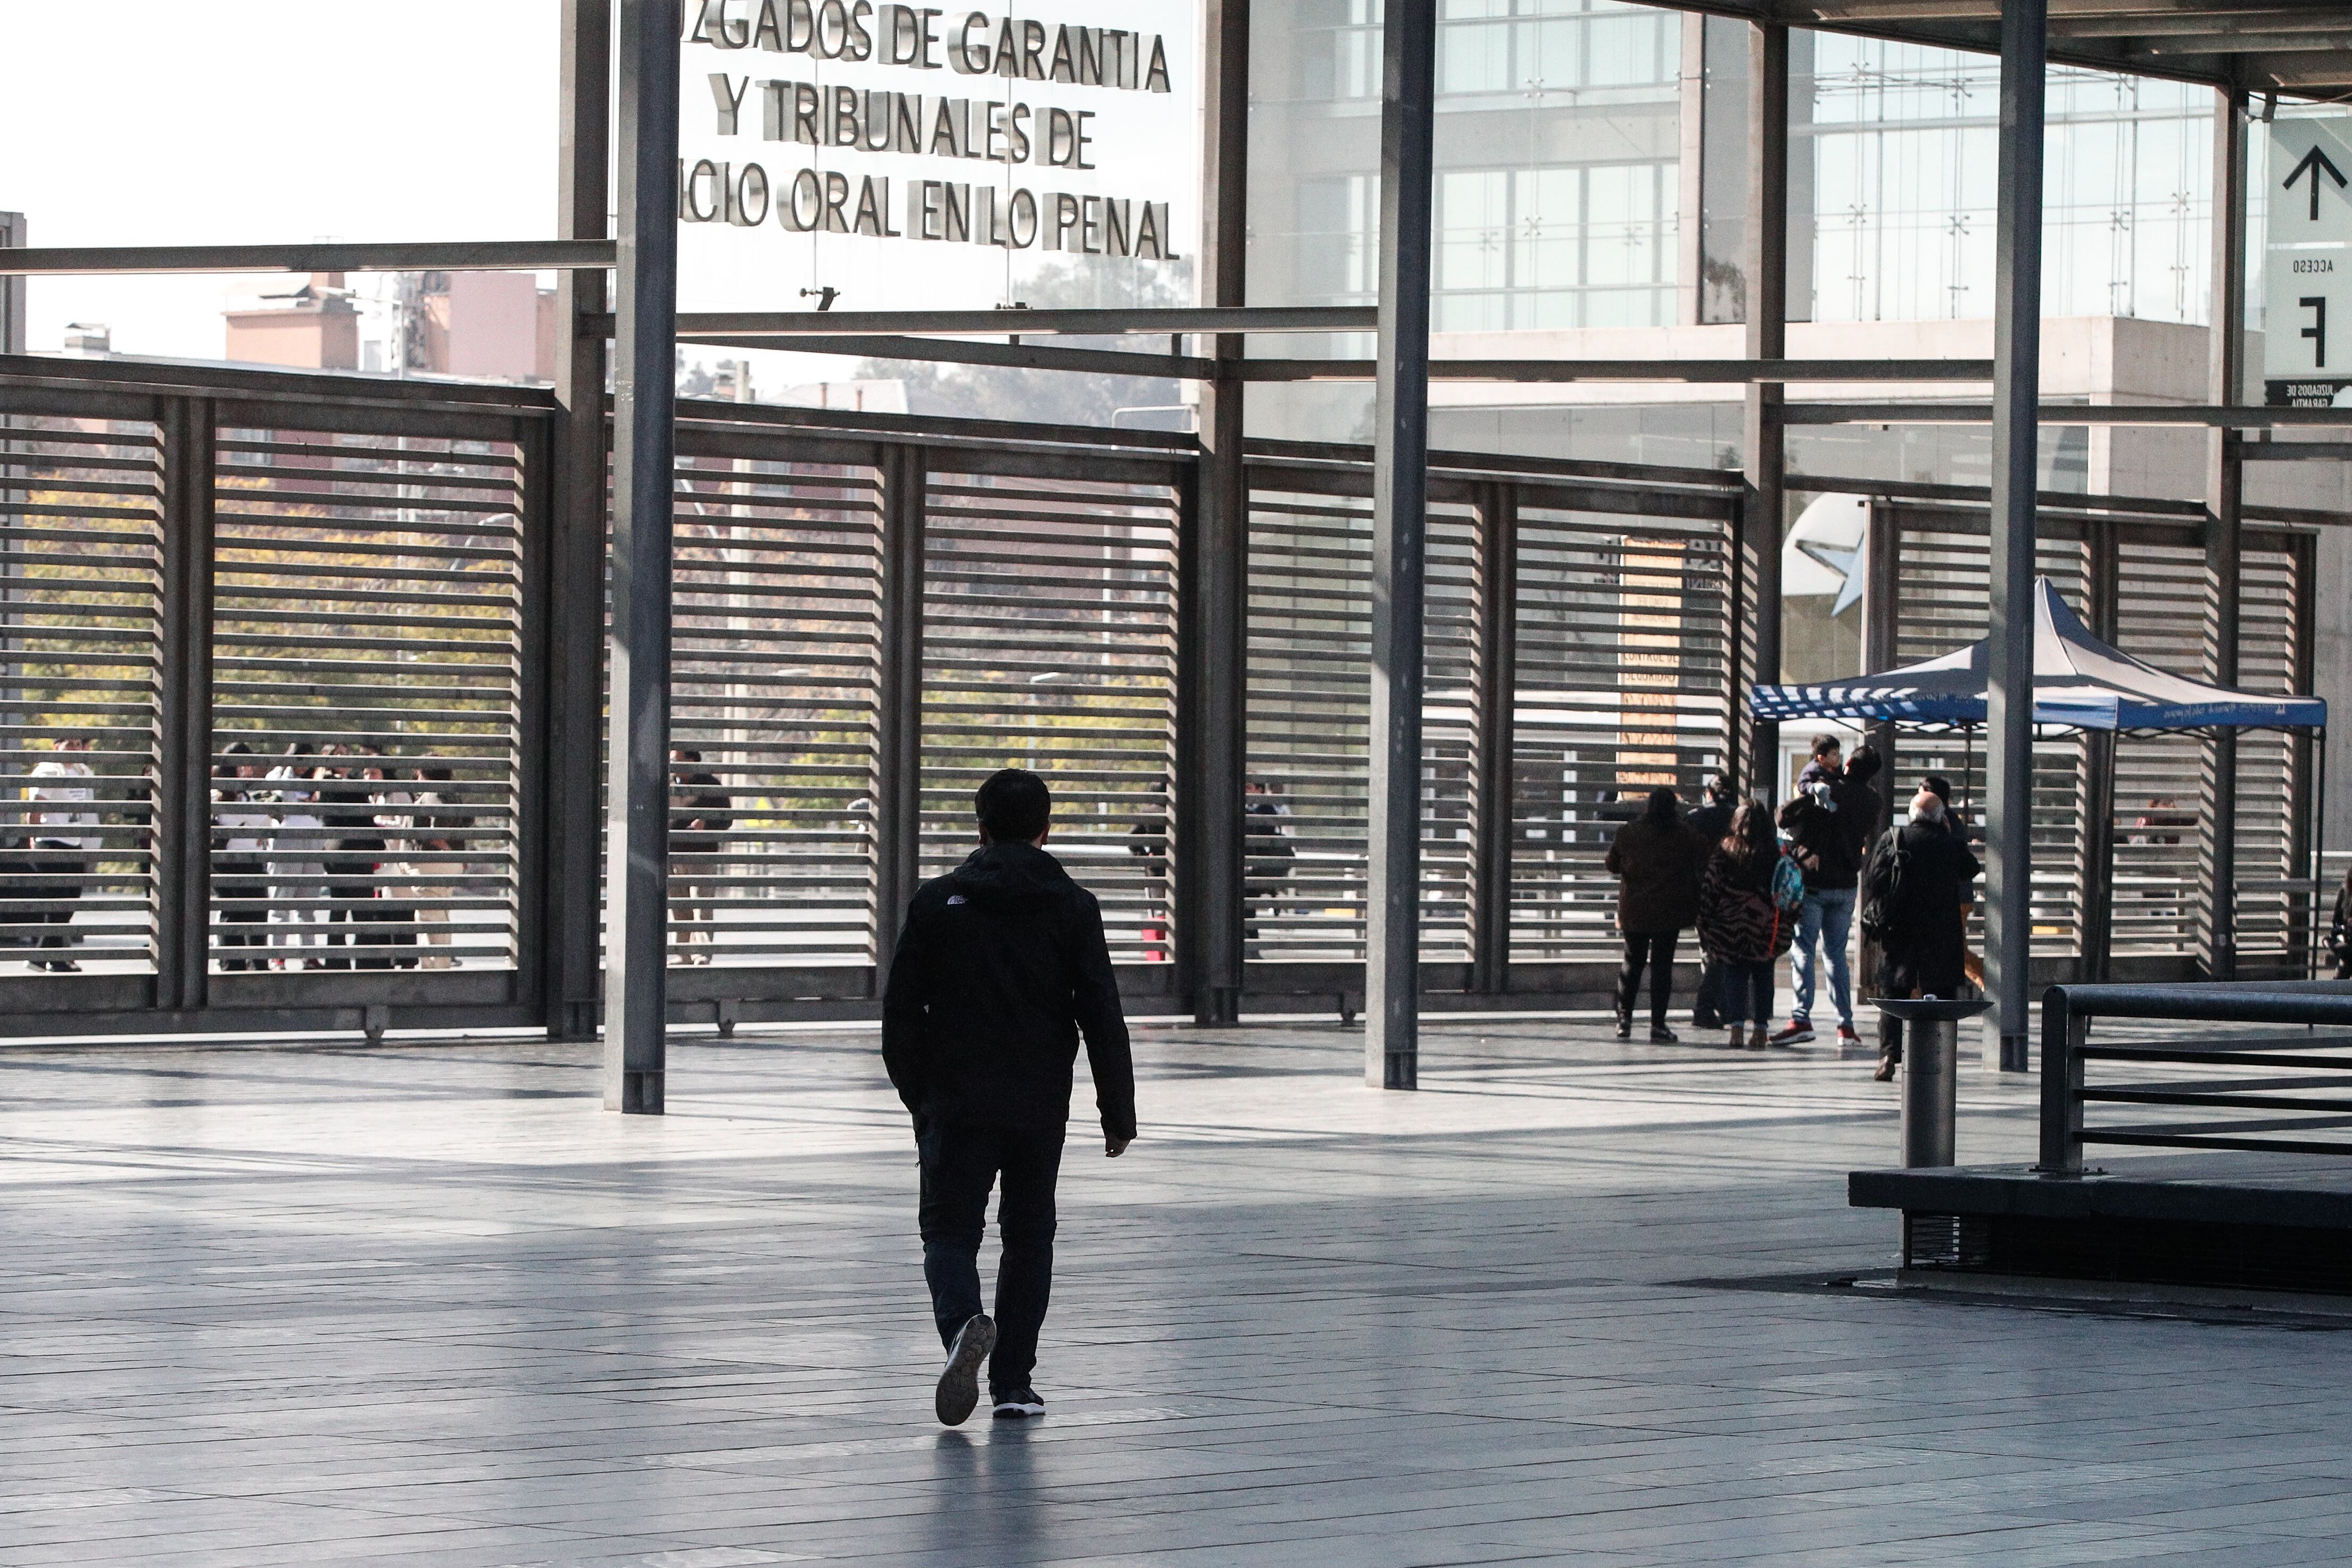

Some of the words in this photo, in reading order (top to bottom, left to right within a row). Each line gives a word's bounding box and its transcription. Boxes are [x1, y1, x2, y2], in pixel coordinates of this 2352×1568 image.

[884, 4, 942, 68] DE
[953, 11, 1171, 93] GARANTIA
[713, 73, 749, 135] Y
[761, 79, 1030, 163] TRIBUNALES
[1041, 107, 1095, 169] DE
[783, 168, 900, 237] ORAL
[914, 180, 970, 242] EN
[982, 186, 1037, 248] LO
[1048, 193, 1179, 260] PENAL
